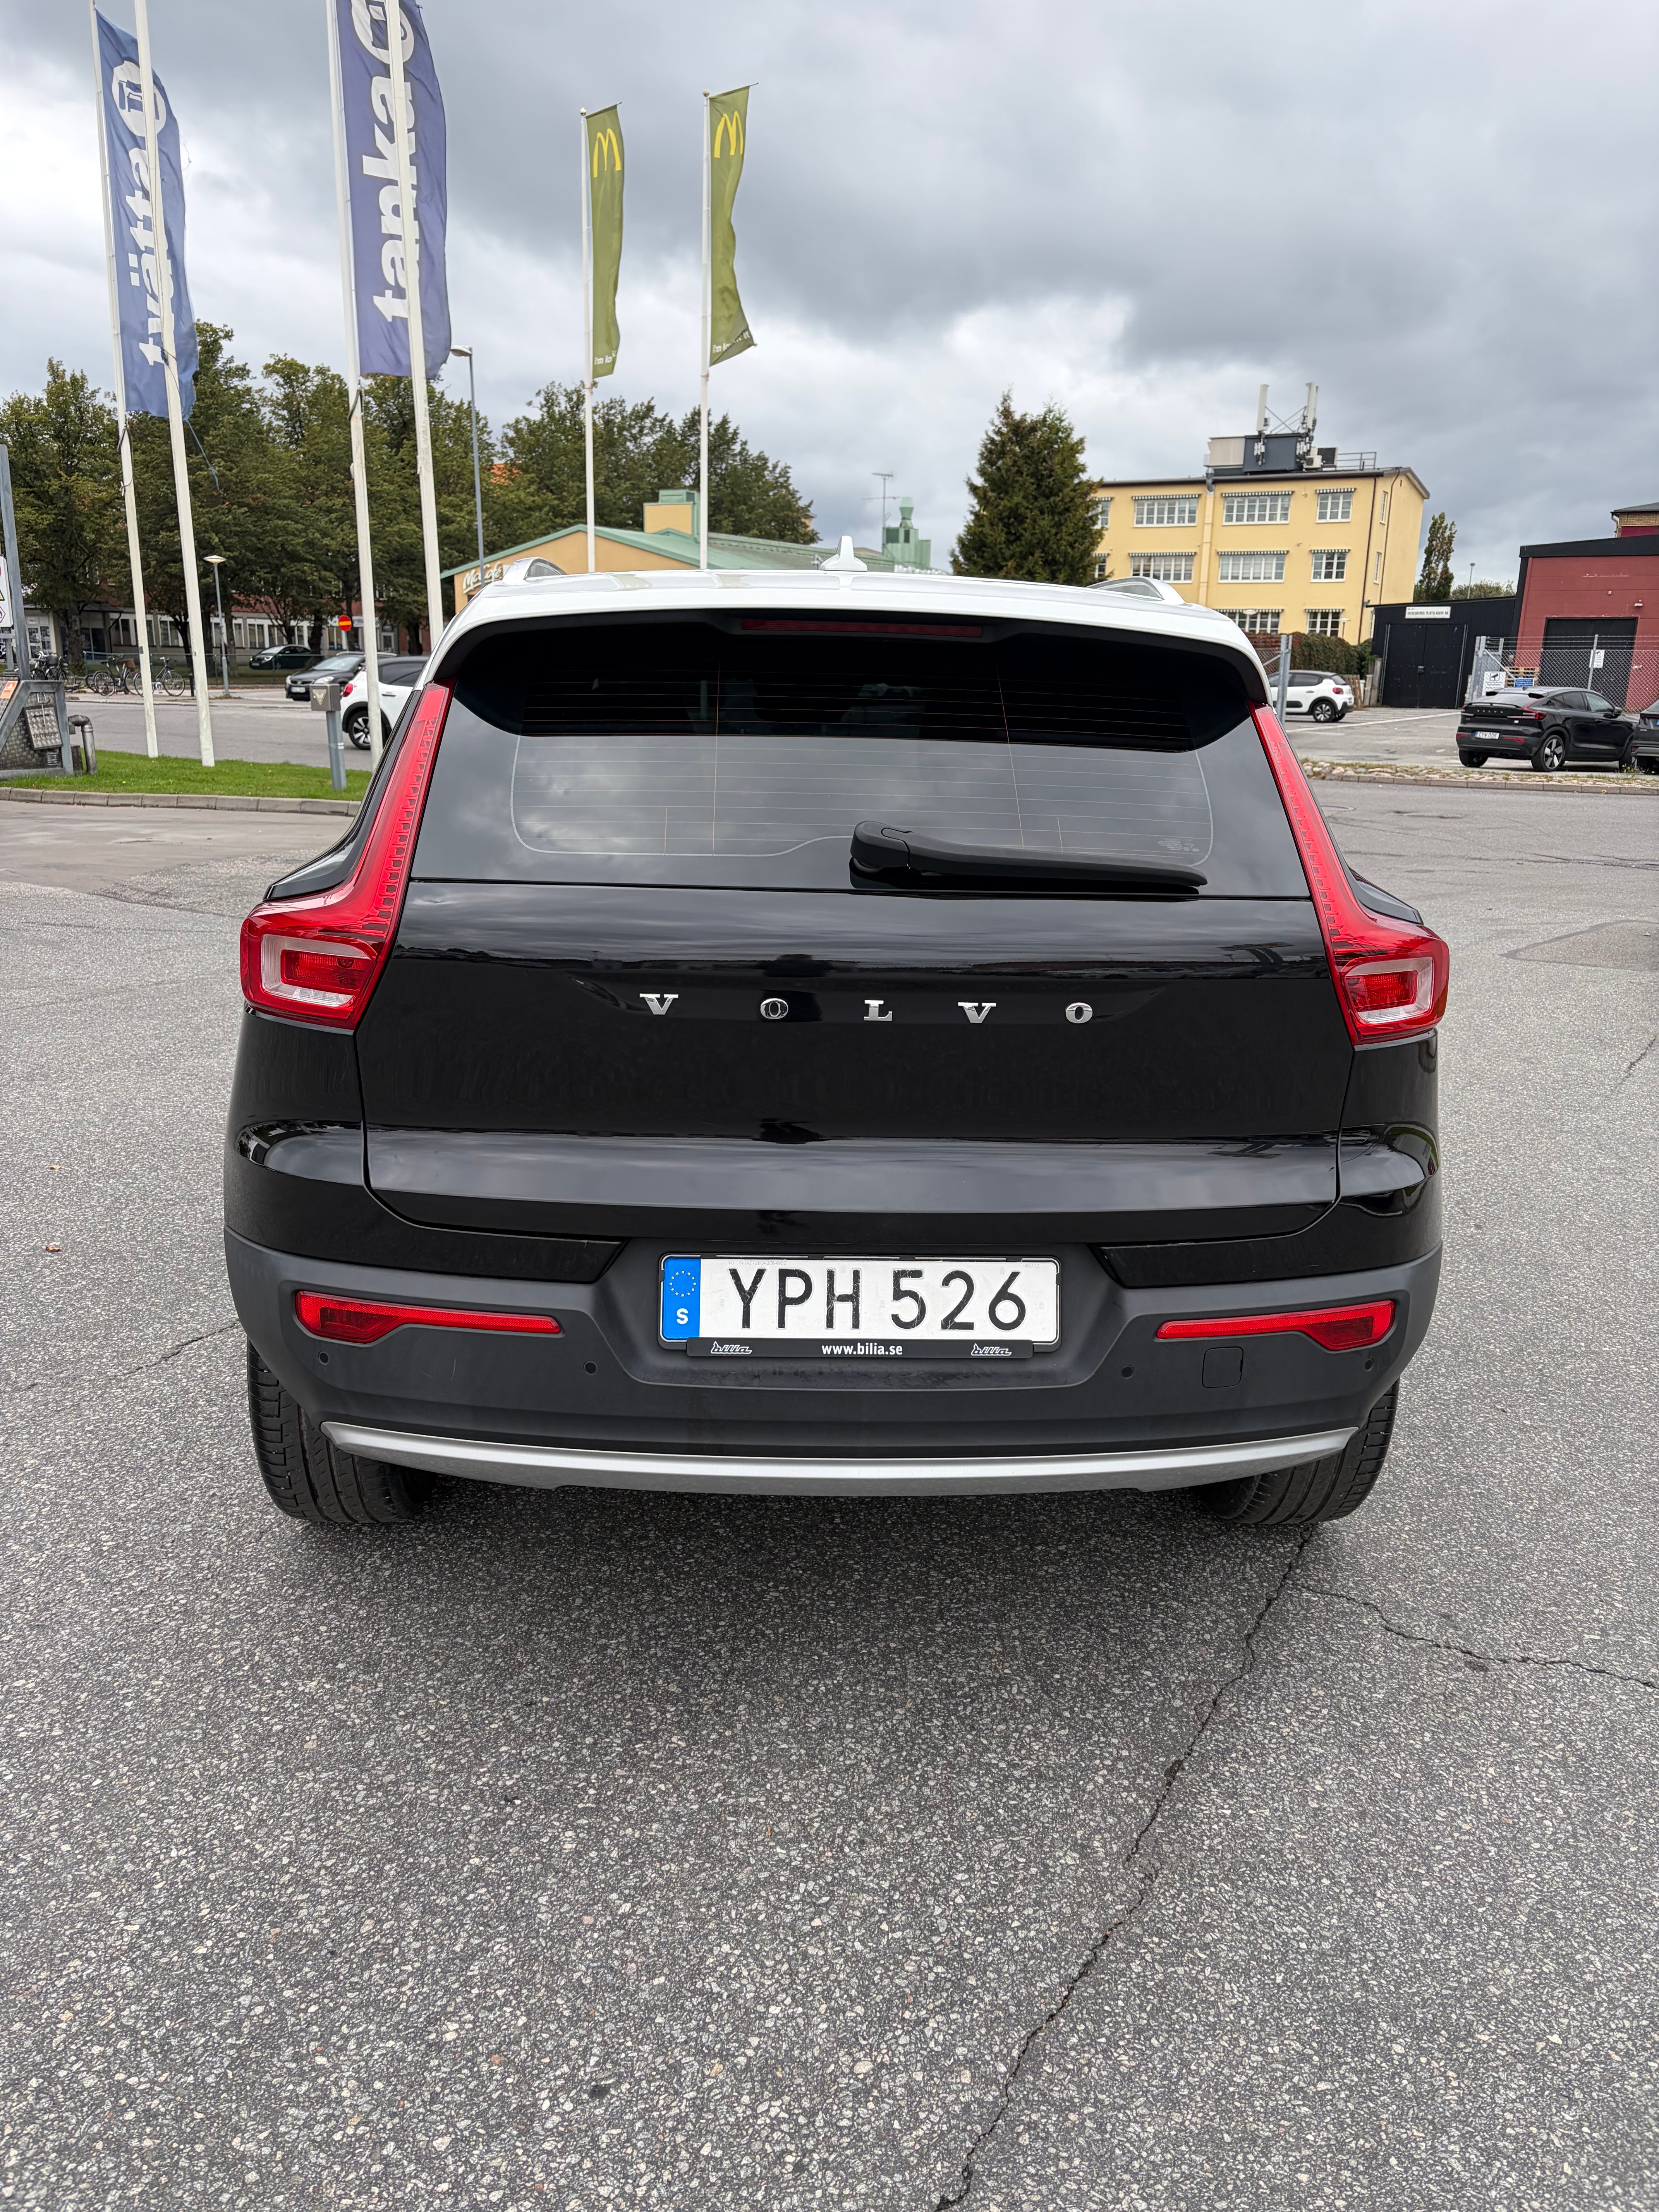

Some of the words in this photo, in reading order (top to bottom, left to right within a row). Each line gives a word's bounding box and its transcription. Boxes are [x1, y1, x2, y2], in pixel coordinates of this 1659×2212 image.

[362, 76, 419, 322] tanka
[125, 147, 174, 366] tvätta
[639, 993, 1093, 1024] VOLVO
[676, 1308, 688, 1324] S
[729, 1268, 860, 1329] YPH
[891, 1270, 1026, 1331] 526
[711, 1341, 752, 1354] bilia
[821, 1342, 903, 1355] www.bilia.se
[971, 1343, 1012, 1356] bilia
